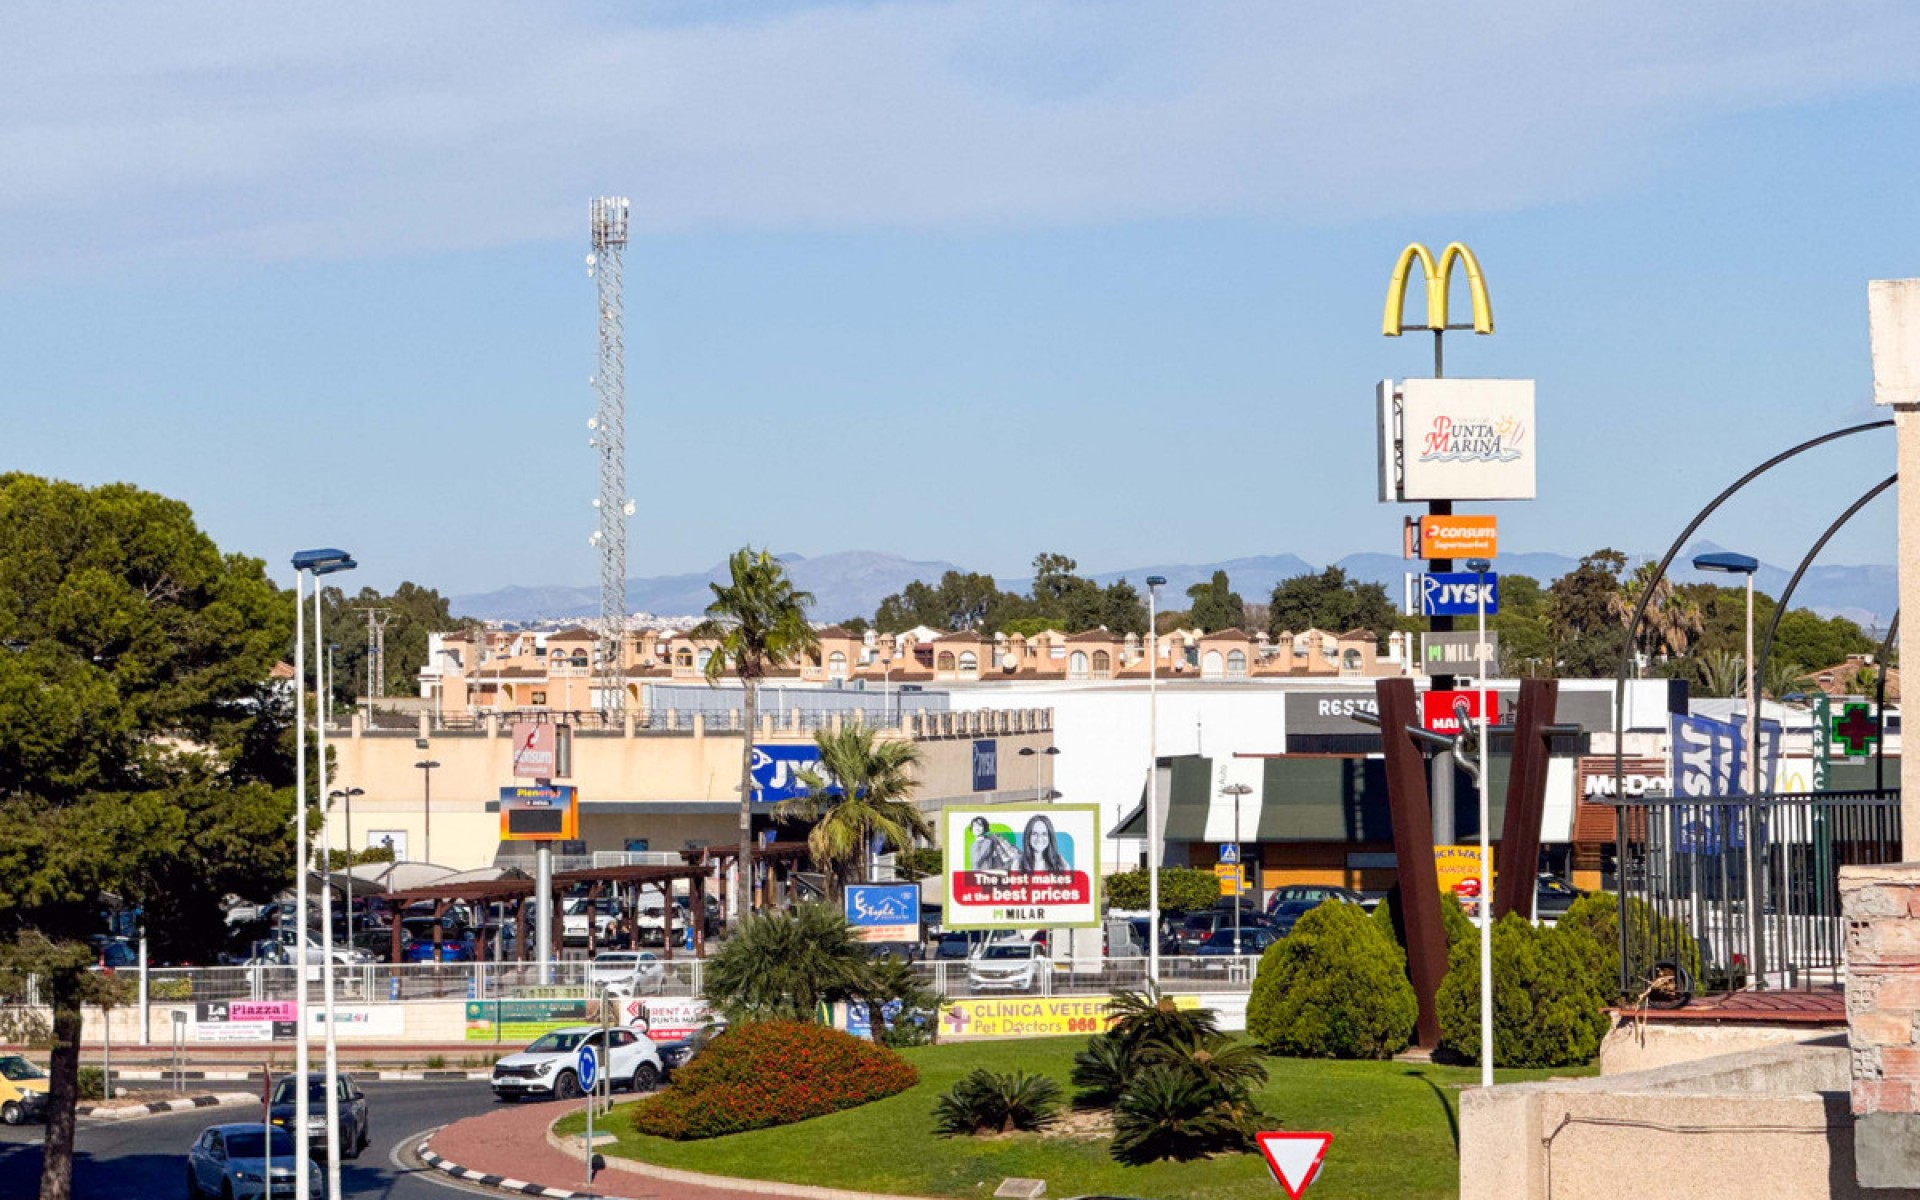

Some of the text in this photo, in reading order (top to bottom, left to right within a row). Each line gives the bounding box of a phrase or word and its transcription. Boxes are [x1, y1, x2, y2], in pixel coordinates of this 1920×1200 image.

[1433, 416, 1494, 437] PUNTA
[1422, 432, 1501, 456] MARINA
[1438, 583, 1494, 604] JYSK
[1444, 643, 1494, 662] MILAR
[1318, 699, 1379, 716] RESTA
[974, 874, 1001, 886] The
[1031, 873, 1073, 886] makes
[962, 887, 1081, 904] at the best prices
[1005, 908, 1045, 920] MILAR
[975, 1002, 1043, 1017] CLÍNICA
[975, 1019, 996, 1033] Pet
[1002, 1018, 1061, 1034] Doctors
